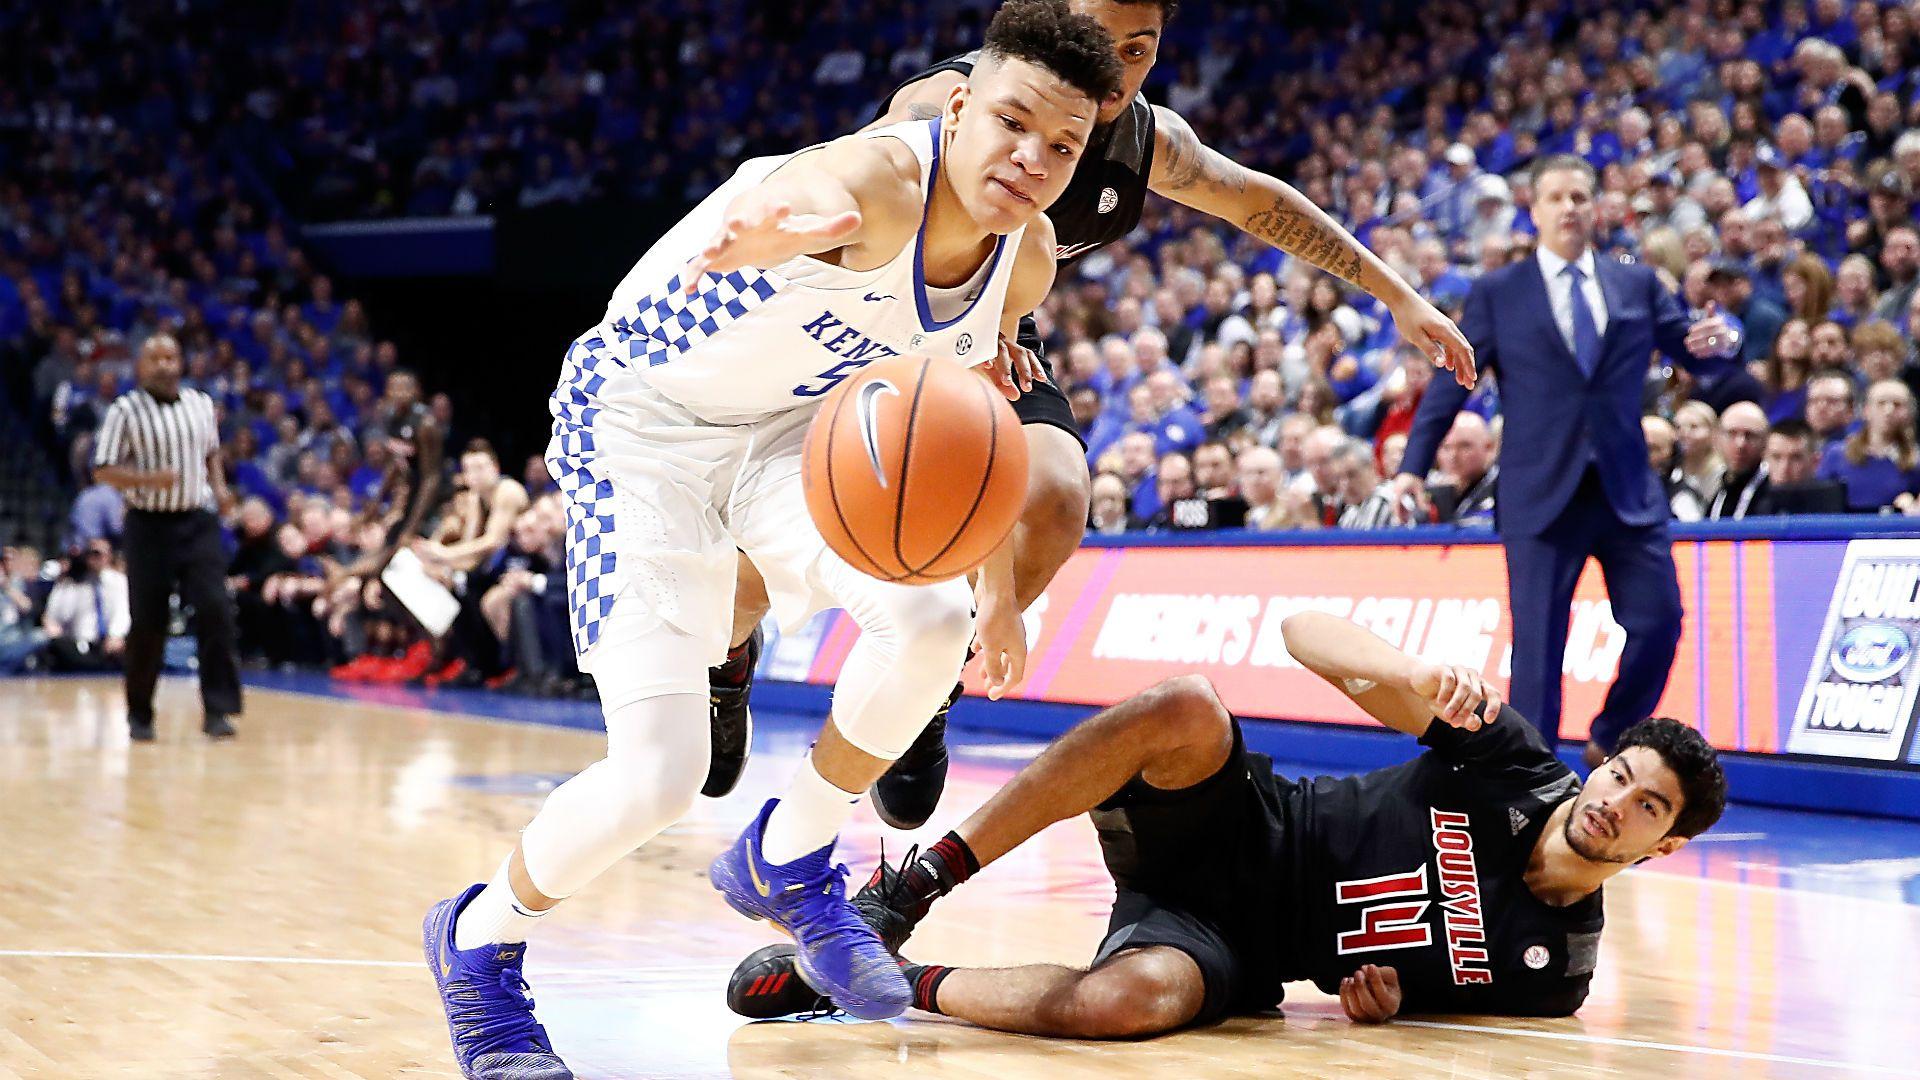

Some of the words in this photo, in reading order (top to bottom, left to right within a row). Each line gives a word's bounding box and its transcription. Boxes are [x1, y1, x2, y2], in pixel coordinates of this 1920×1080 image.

[792, 359, 875, 397] 5
[1842, 563, 1920, 619] BUIL
[1810, 681, 1904, 731] TOUGH
[1335, 862, 1432, 955] 14
[1430, 806, 1493, 986] LOUISVILLE
